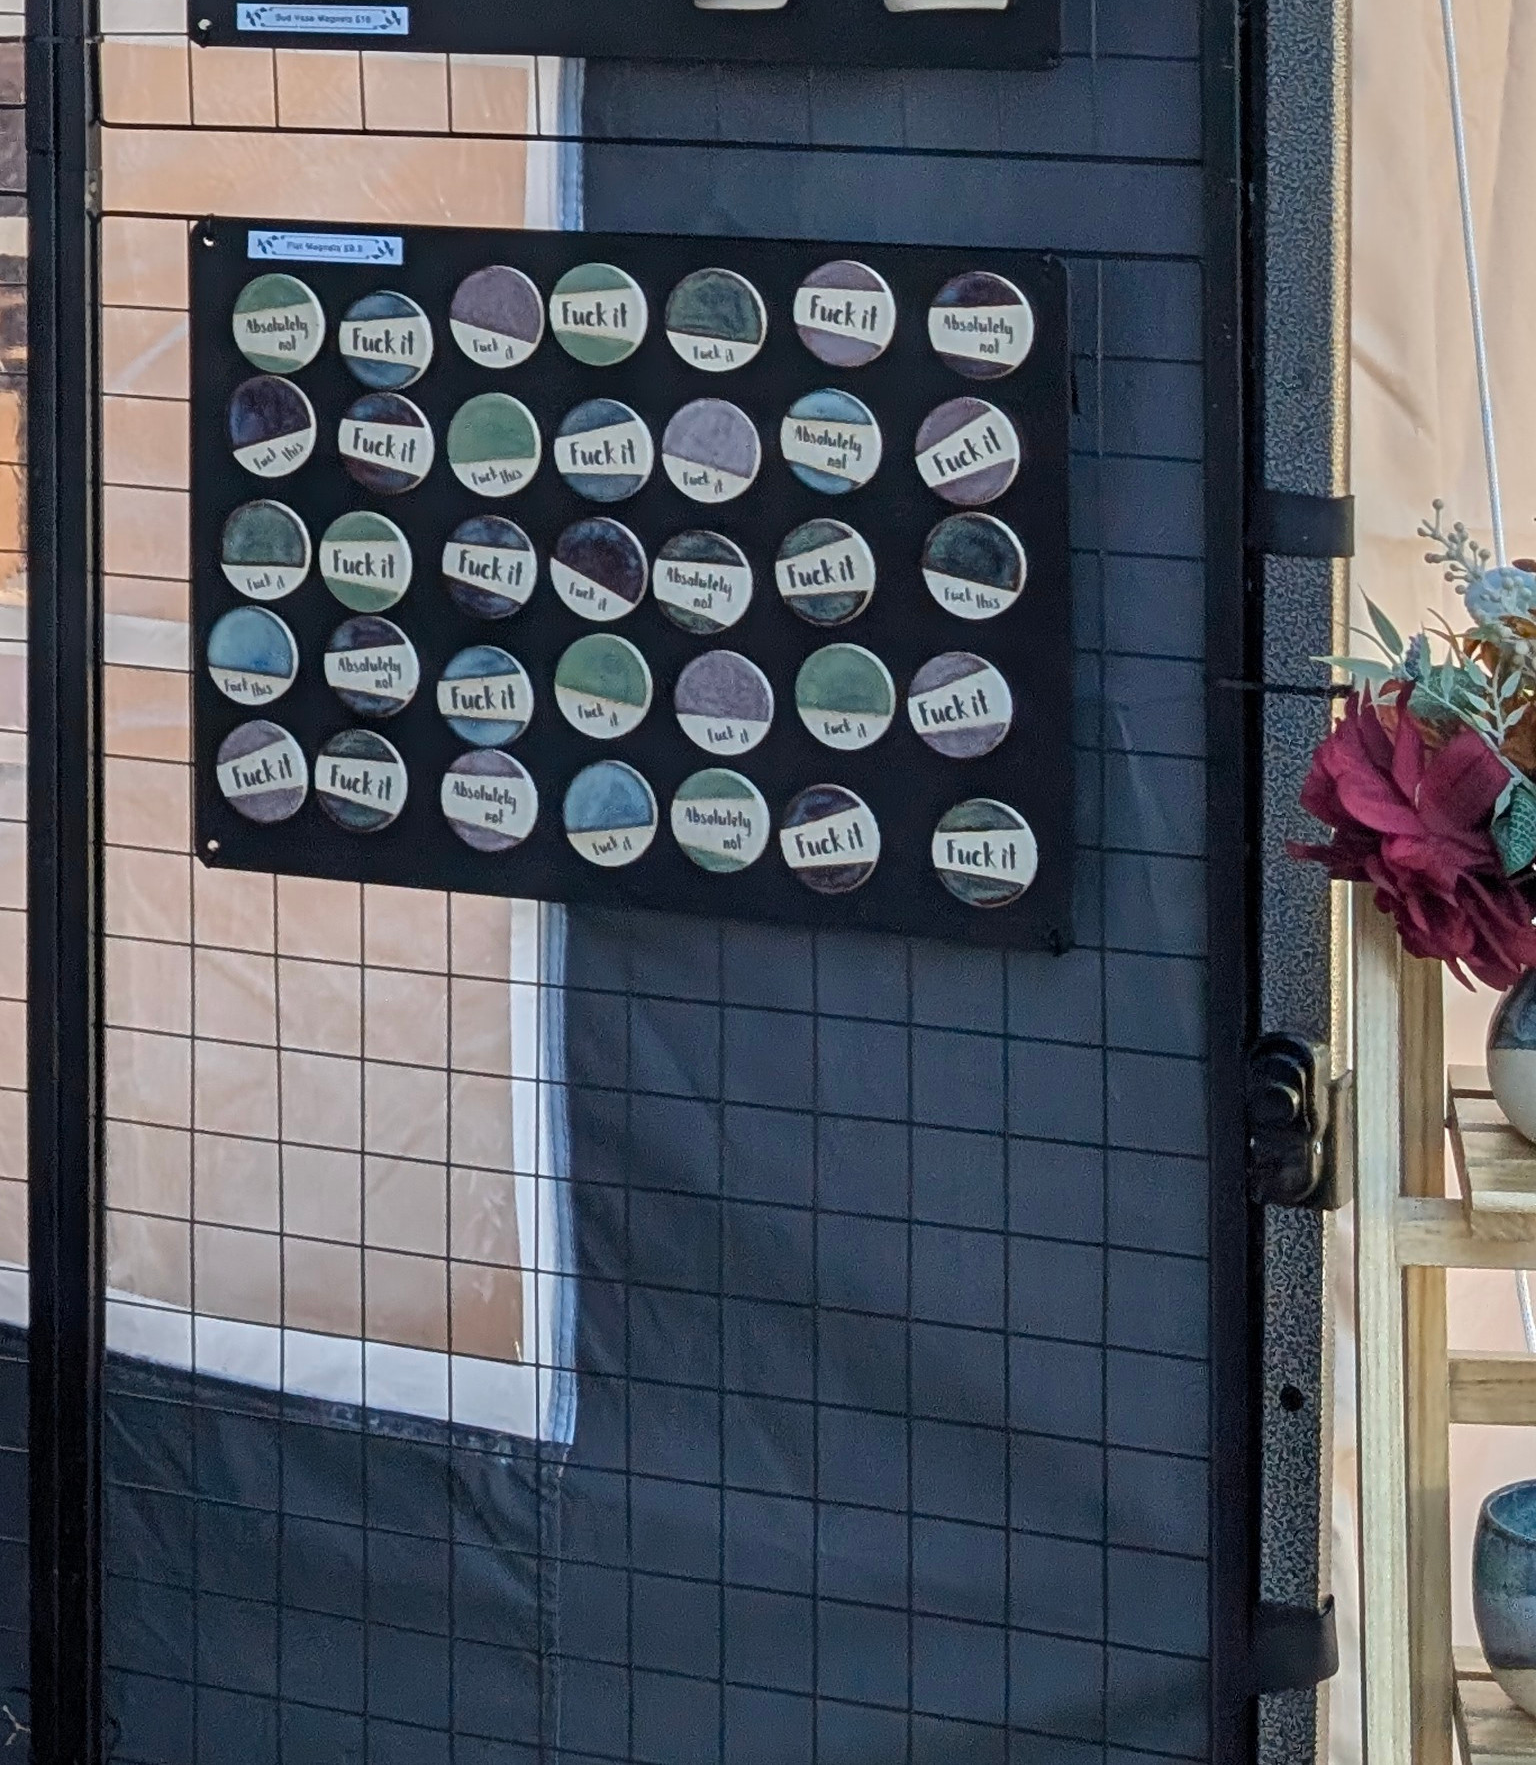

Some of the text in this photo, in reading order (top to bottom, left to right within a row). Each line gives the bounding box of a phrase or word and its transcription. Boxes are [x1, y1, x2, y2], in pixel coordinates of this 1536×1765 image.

[246, 316, 309, 339] Absolutely
[562, 302, 627, 327] Fuck it
[809, 296, 878, 331] Fuck it
[278, 336, 296, 351] not
[353, 328, 414, 355] Fuck it
[943, 315, 1014, 343] Absolutely
[979, 339, 1000, 354] not
[353, 428, 417, 463] Fuck it
[570, 439, 635, 466] Fuck it
[795, 426, 863, 460] Absolutely
[933, 426, 1001, 477] Fuck it
[827, 454, 847, 469] not
[333, 549, 395, 578] Fuck it
[458, 550, 523, 587] Fuck it
[787, 555, 855, 588] Fuck it
[666, 567, 732, 601] Absolutely
[693, 596, 712, 609] not
[337, 657, 402, 679] Absolutely
[374, 675, 393, 689] not
[451, 684, 515, 710] Fuck it
[918, 689, 989, 726] Fuck it
[232, 753, 292, 790] Fuck it
[330, 765, 392, 801] Fuck it
[452, 781, 517, 814] Absolutely
[484, 809, 503, 824] not
[684, 806, 752, 836] Absolutely
[723, 836, 742, 851] not
[795, 822, 864, 858] Fuck it
[947, 840, 1016, 870] Fuck it
